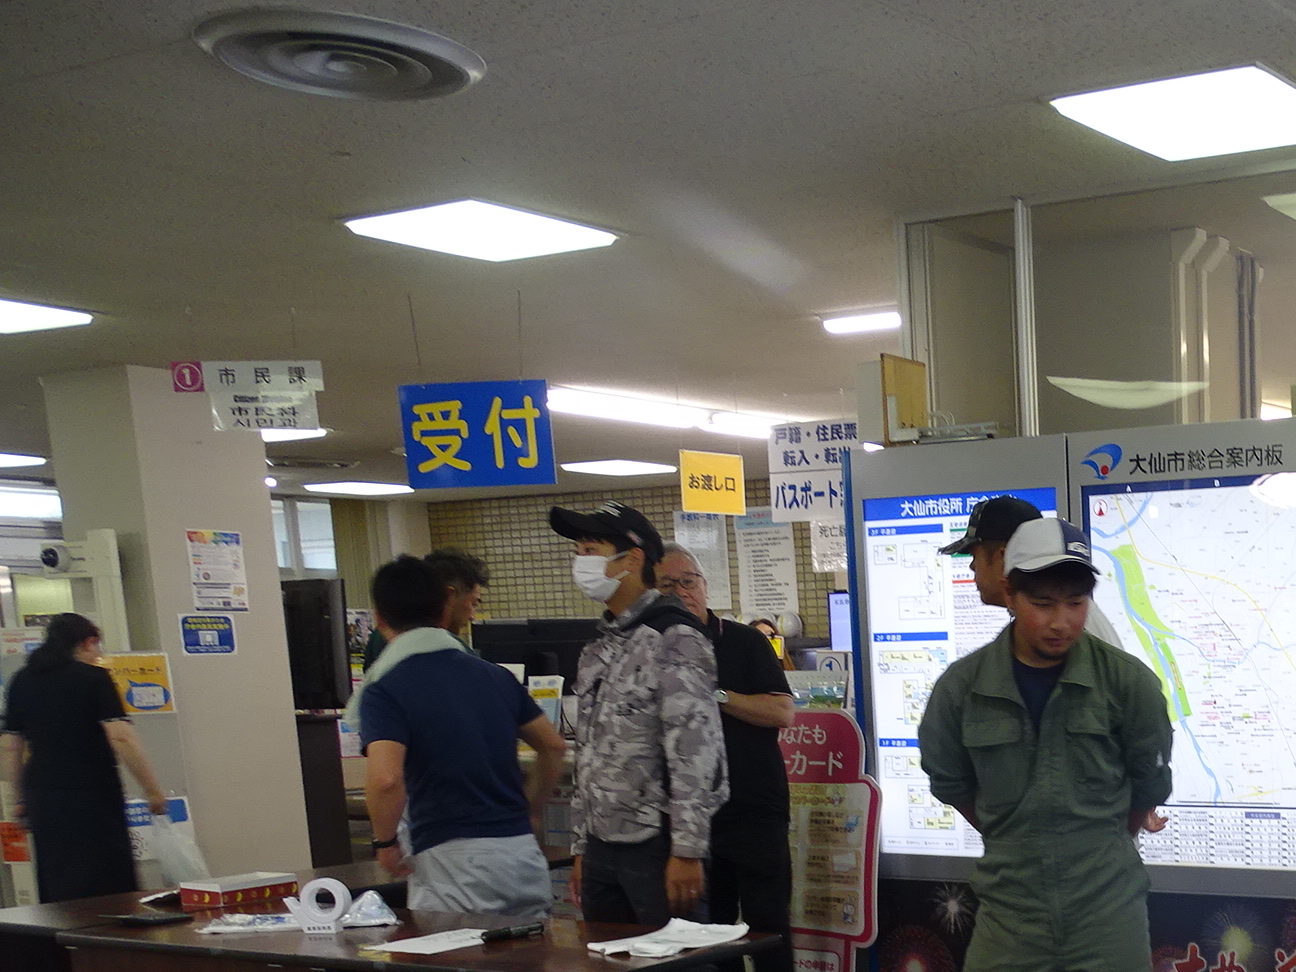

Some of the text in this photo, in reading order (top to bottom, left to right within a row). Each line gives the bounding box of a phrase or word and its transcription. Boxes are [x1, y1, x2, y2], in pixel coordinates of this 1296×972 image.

[217, 366, 307, 386] 市民課
[412, 394, 543, 475] 受付
[773, 422, 858, 446] 戸籍・住民票
[1128, 444, 1284, 476] 大仙市総合案内板
[688, 473, 737, 493] お渡し口
[900, 497, 963, 517] 大仙市役所
